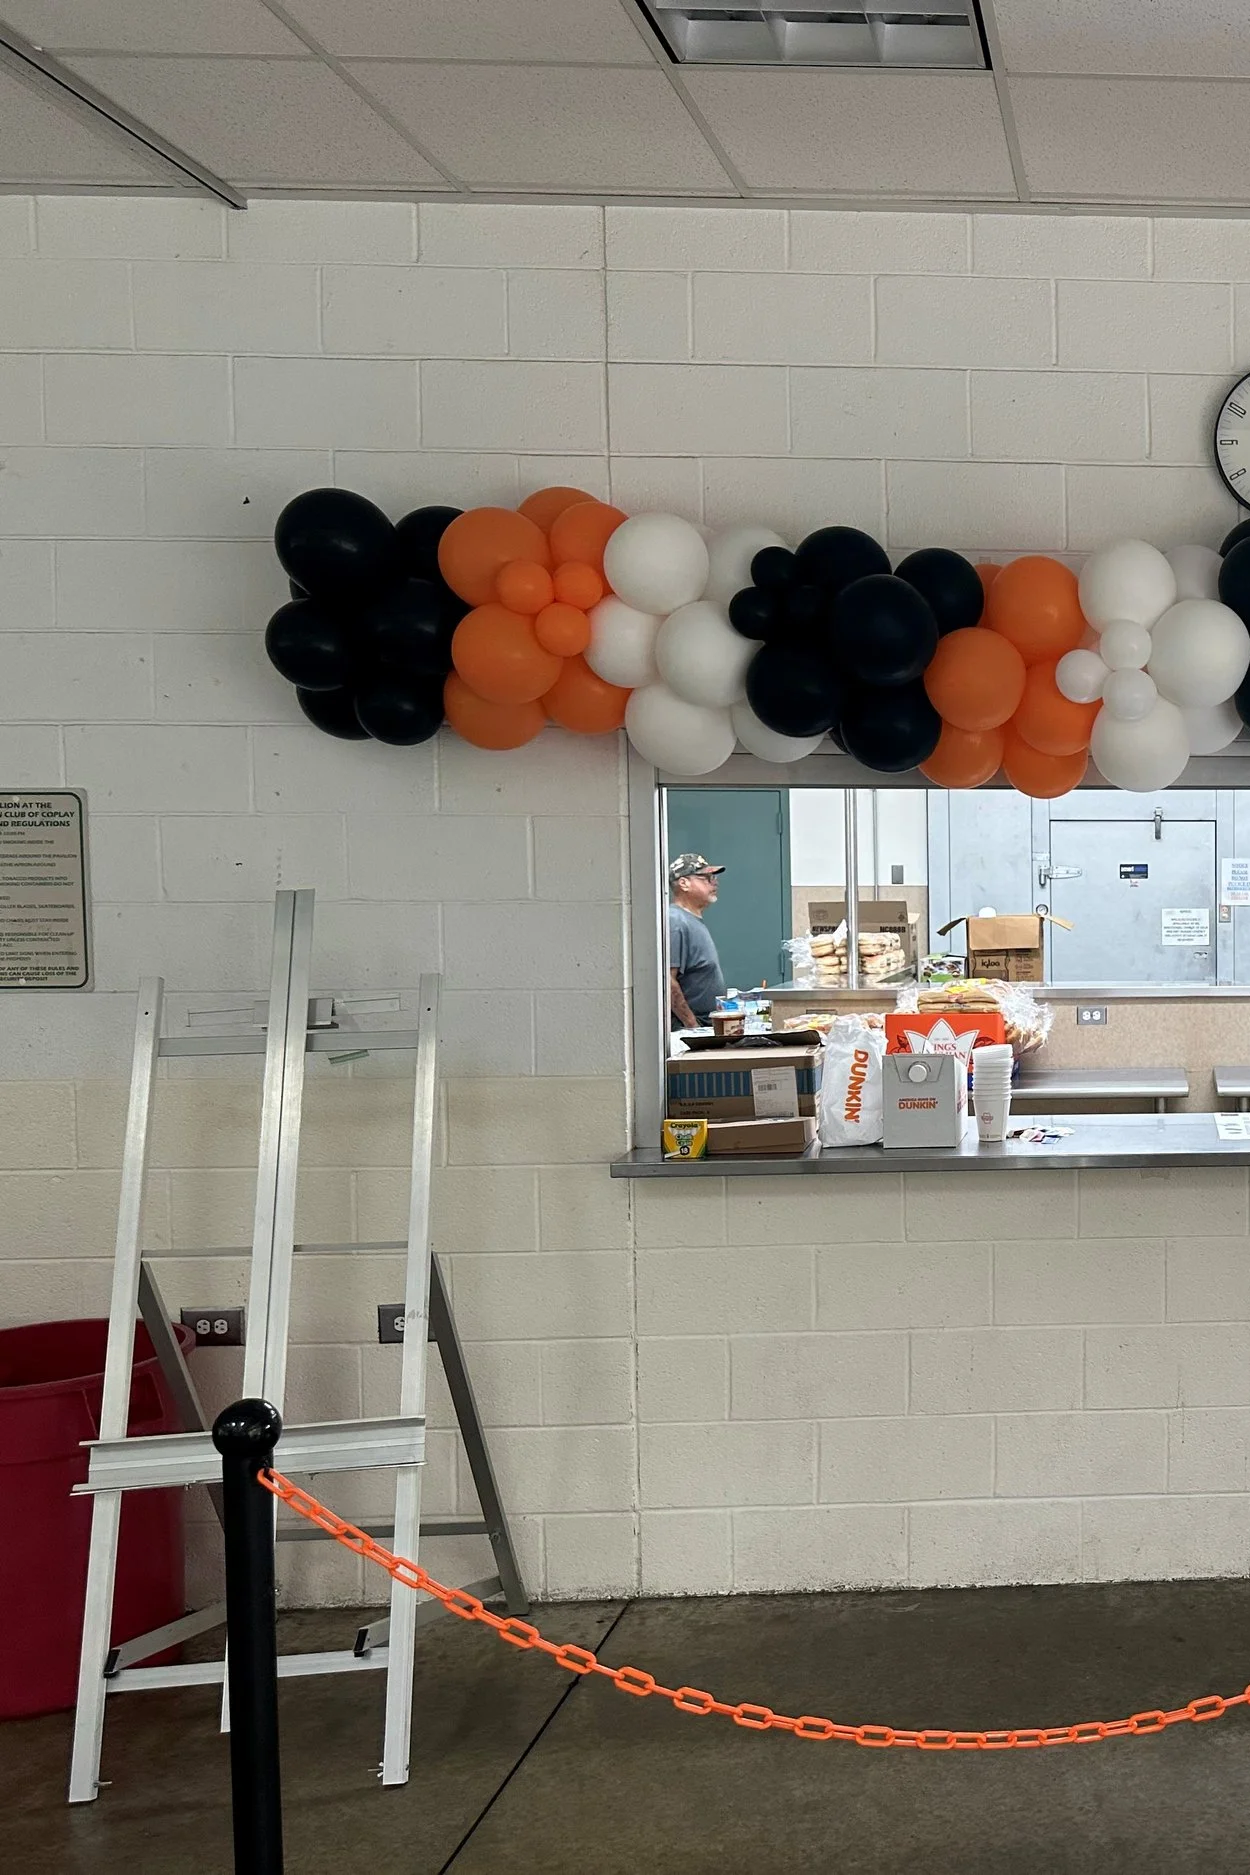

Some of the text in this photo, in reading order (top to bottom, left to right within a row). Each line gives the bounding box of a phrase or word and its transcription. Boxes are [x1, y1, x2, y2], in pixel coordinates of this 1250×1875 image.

[1227, 402, 1246, 418] 10
[1230, 468, 1246, 481] 8
[982, 960, 1000, 968] igloo
